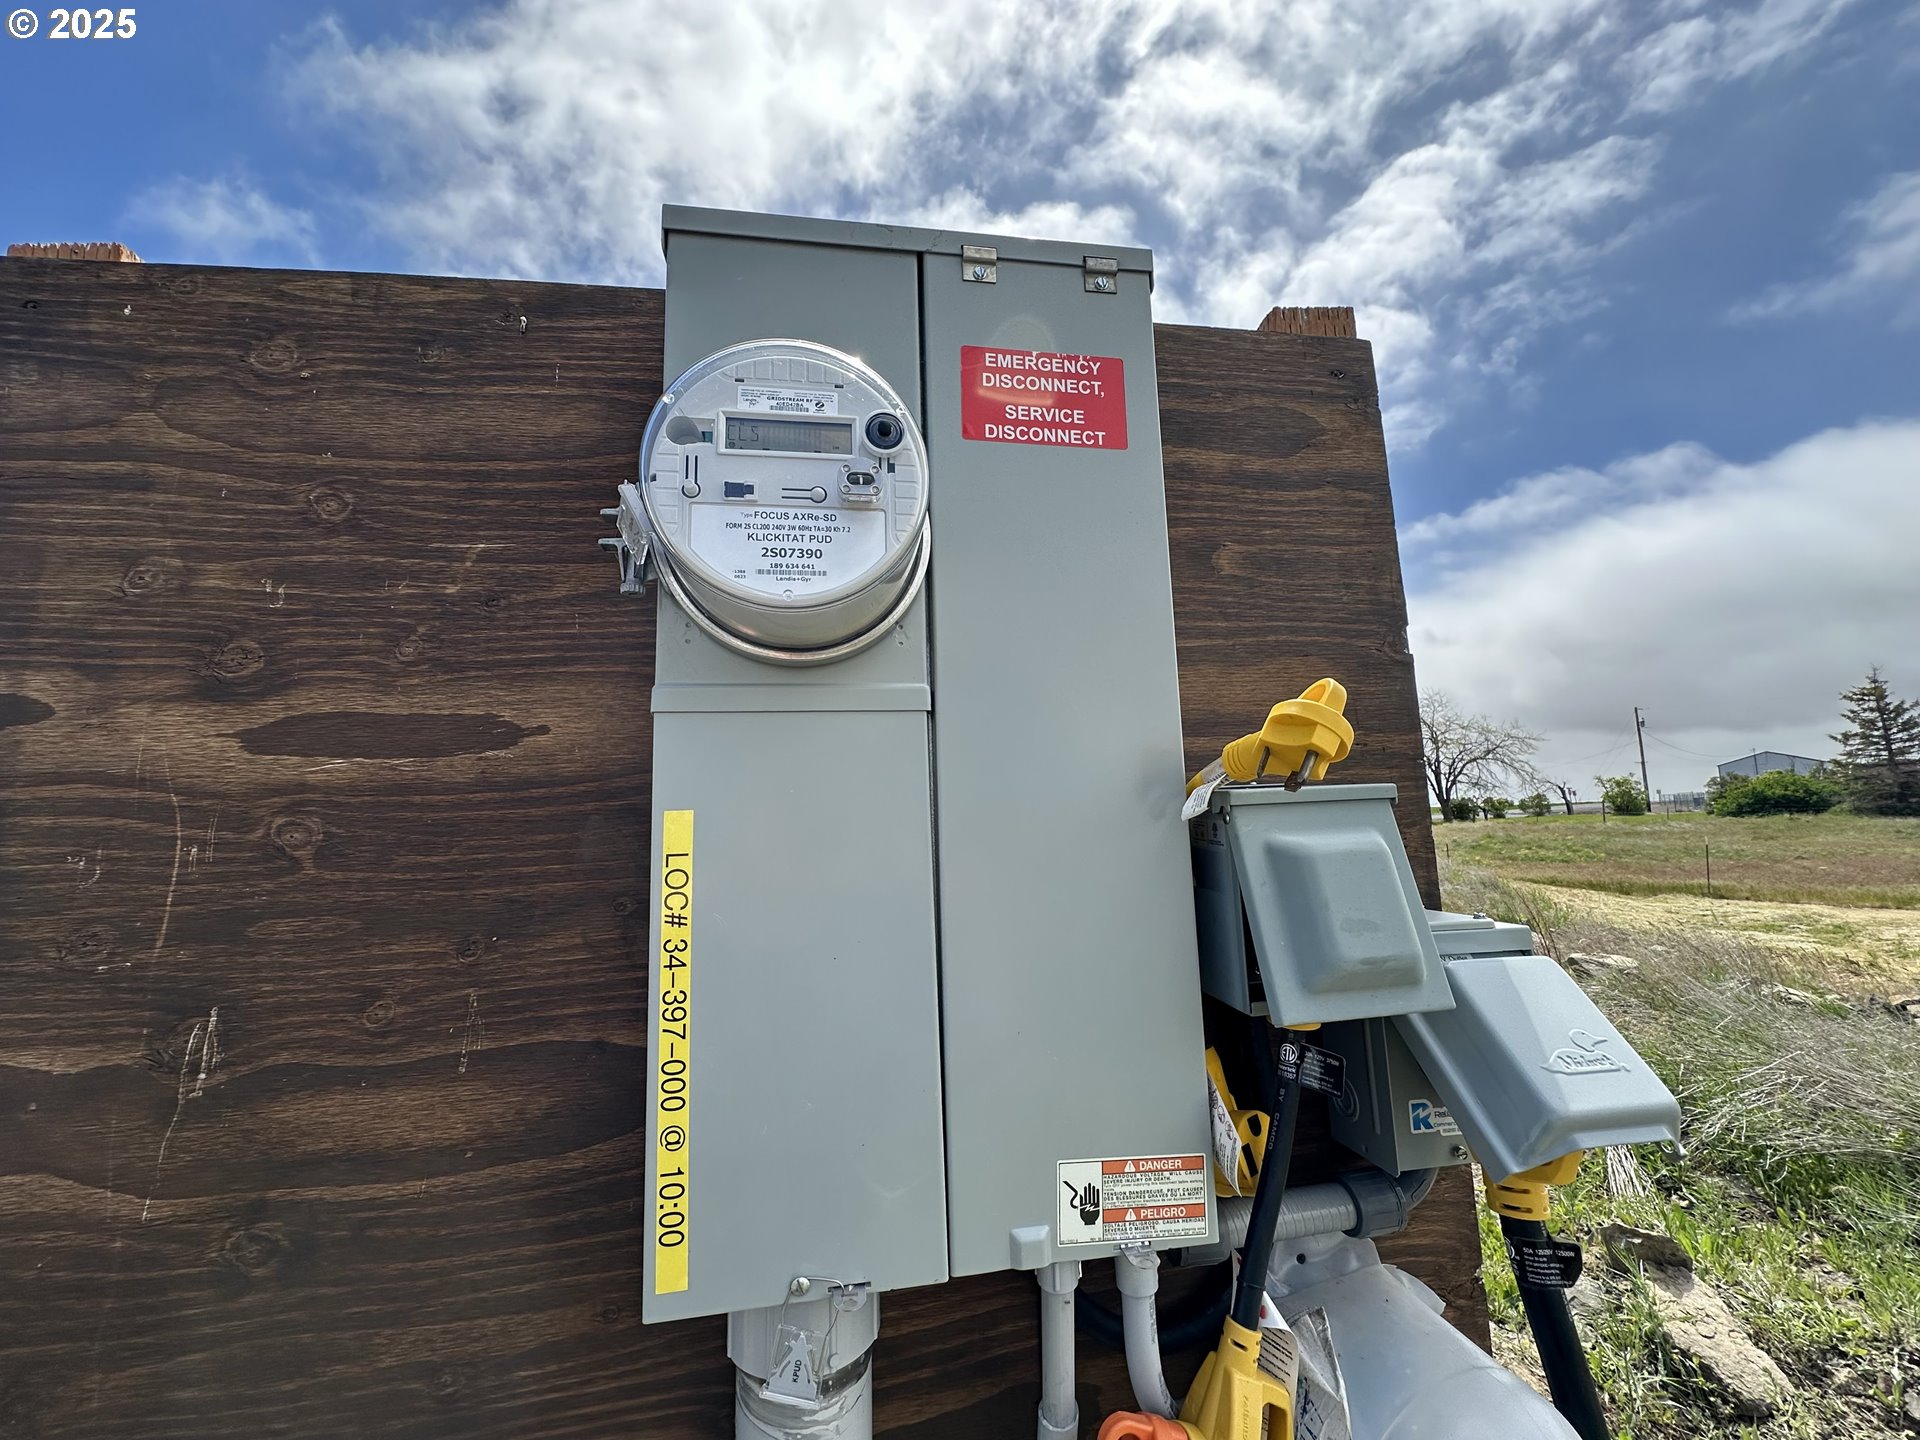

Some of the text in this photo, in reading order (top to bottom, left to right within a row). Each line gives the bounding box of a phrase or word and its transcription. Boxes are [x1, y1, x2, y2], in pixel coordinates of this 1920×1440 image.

[985, 352, 1101, 376] EMERGENCY
[982, 372, 1105, 398] DISCONNECT,
[1005, 404, 1085, 424] SERVICE
[984, 424, 1106, 446] DISCONNECT
[754, 511, 790, 520] FOCUS
[792, 512, 837, 522] AXRe-SD
[747, 533, 833, 544] KLICKITAT PUD
[761, 547, 823, 559] 2S07390
[658, 852, 689, 1248] LOC# 34-397-000 @ 10:00
[1268, 1112, 1280, 1150] CAMCO
[1140, 1160, 1182, 1170] DANGER
[1140, 1207, 1186, 1219] PELIGRO
[792, 1359, 802, 1383] KPUD
